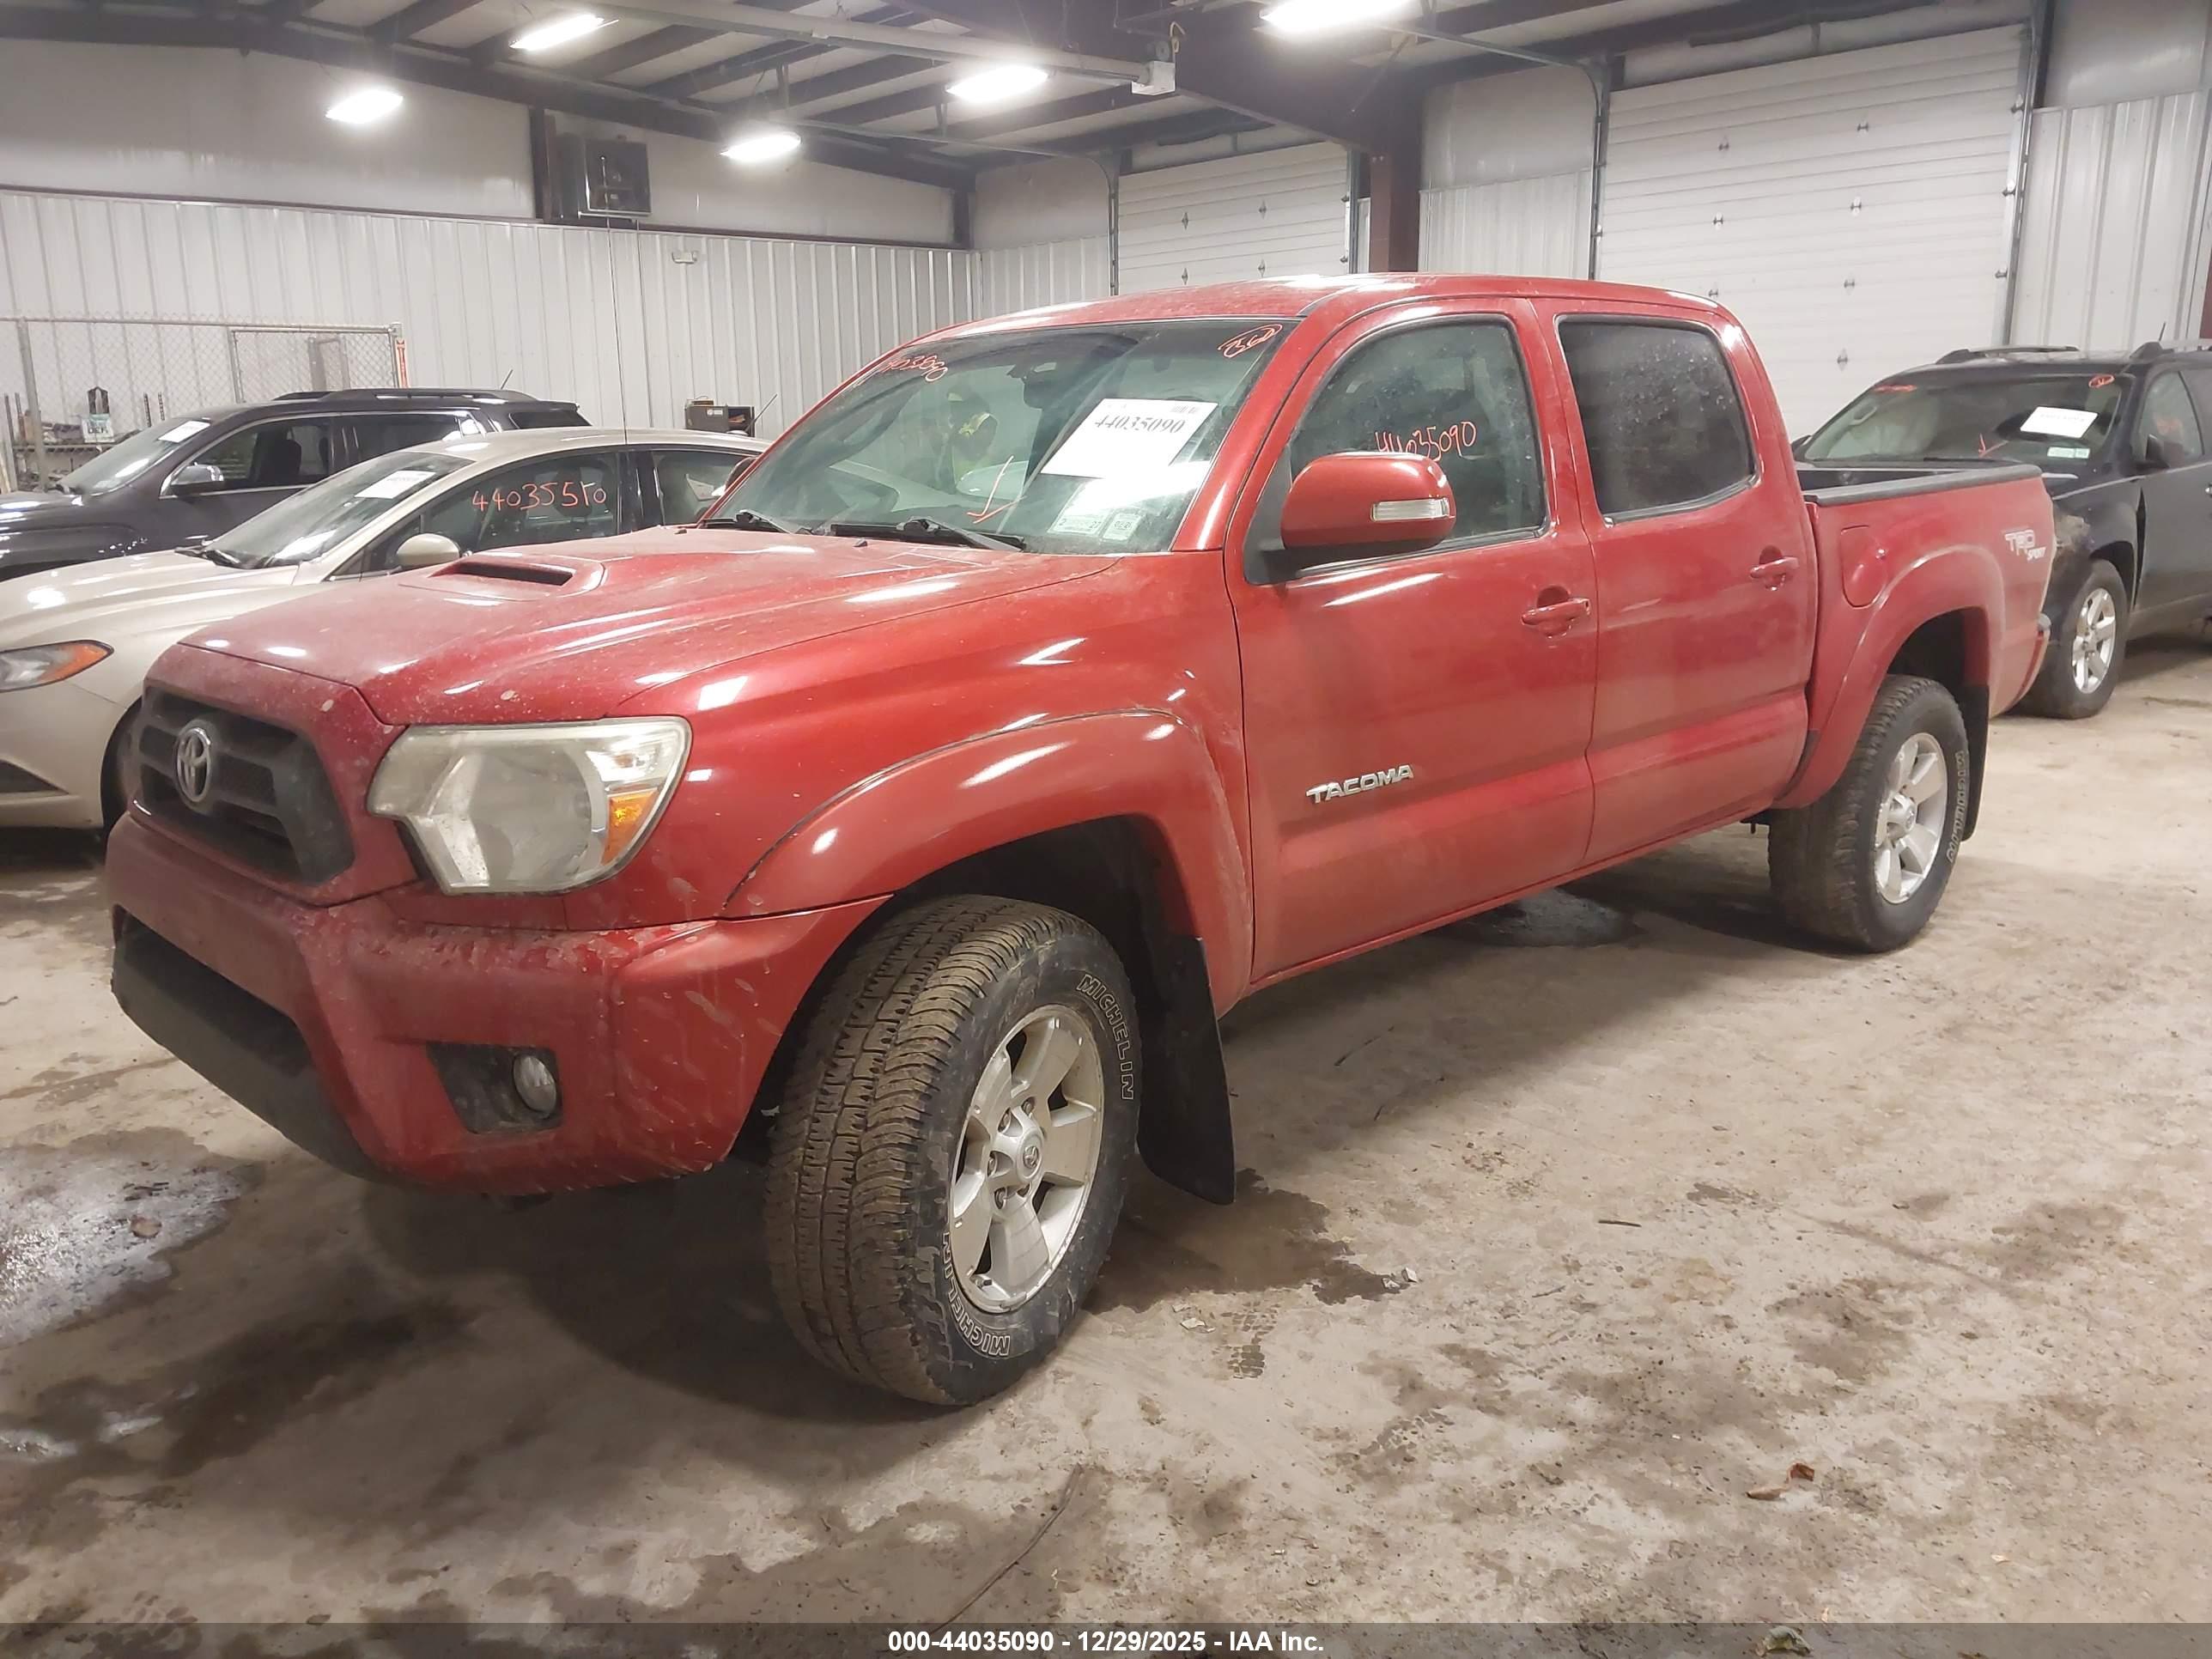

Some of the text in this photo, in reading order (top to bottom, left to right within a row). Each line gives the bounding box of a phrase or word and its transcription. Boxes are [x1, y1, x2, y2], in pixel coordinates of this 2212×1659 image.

[1095, 415, 1186, 433] 44035090
[1305, 764, 1414, 804] TACOMA
[1076, 974, 1134, 1100] MICHELIN
[942, 1231, 1011, 1357] MICHELIN
